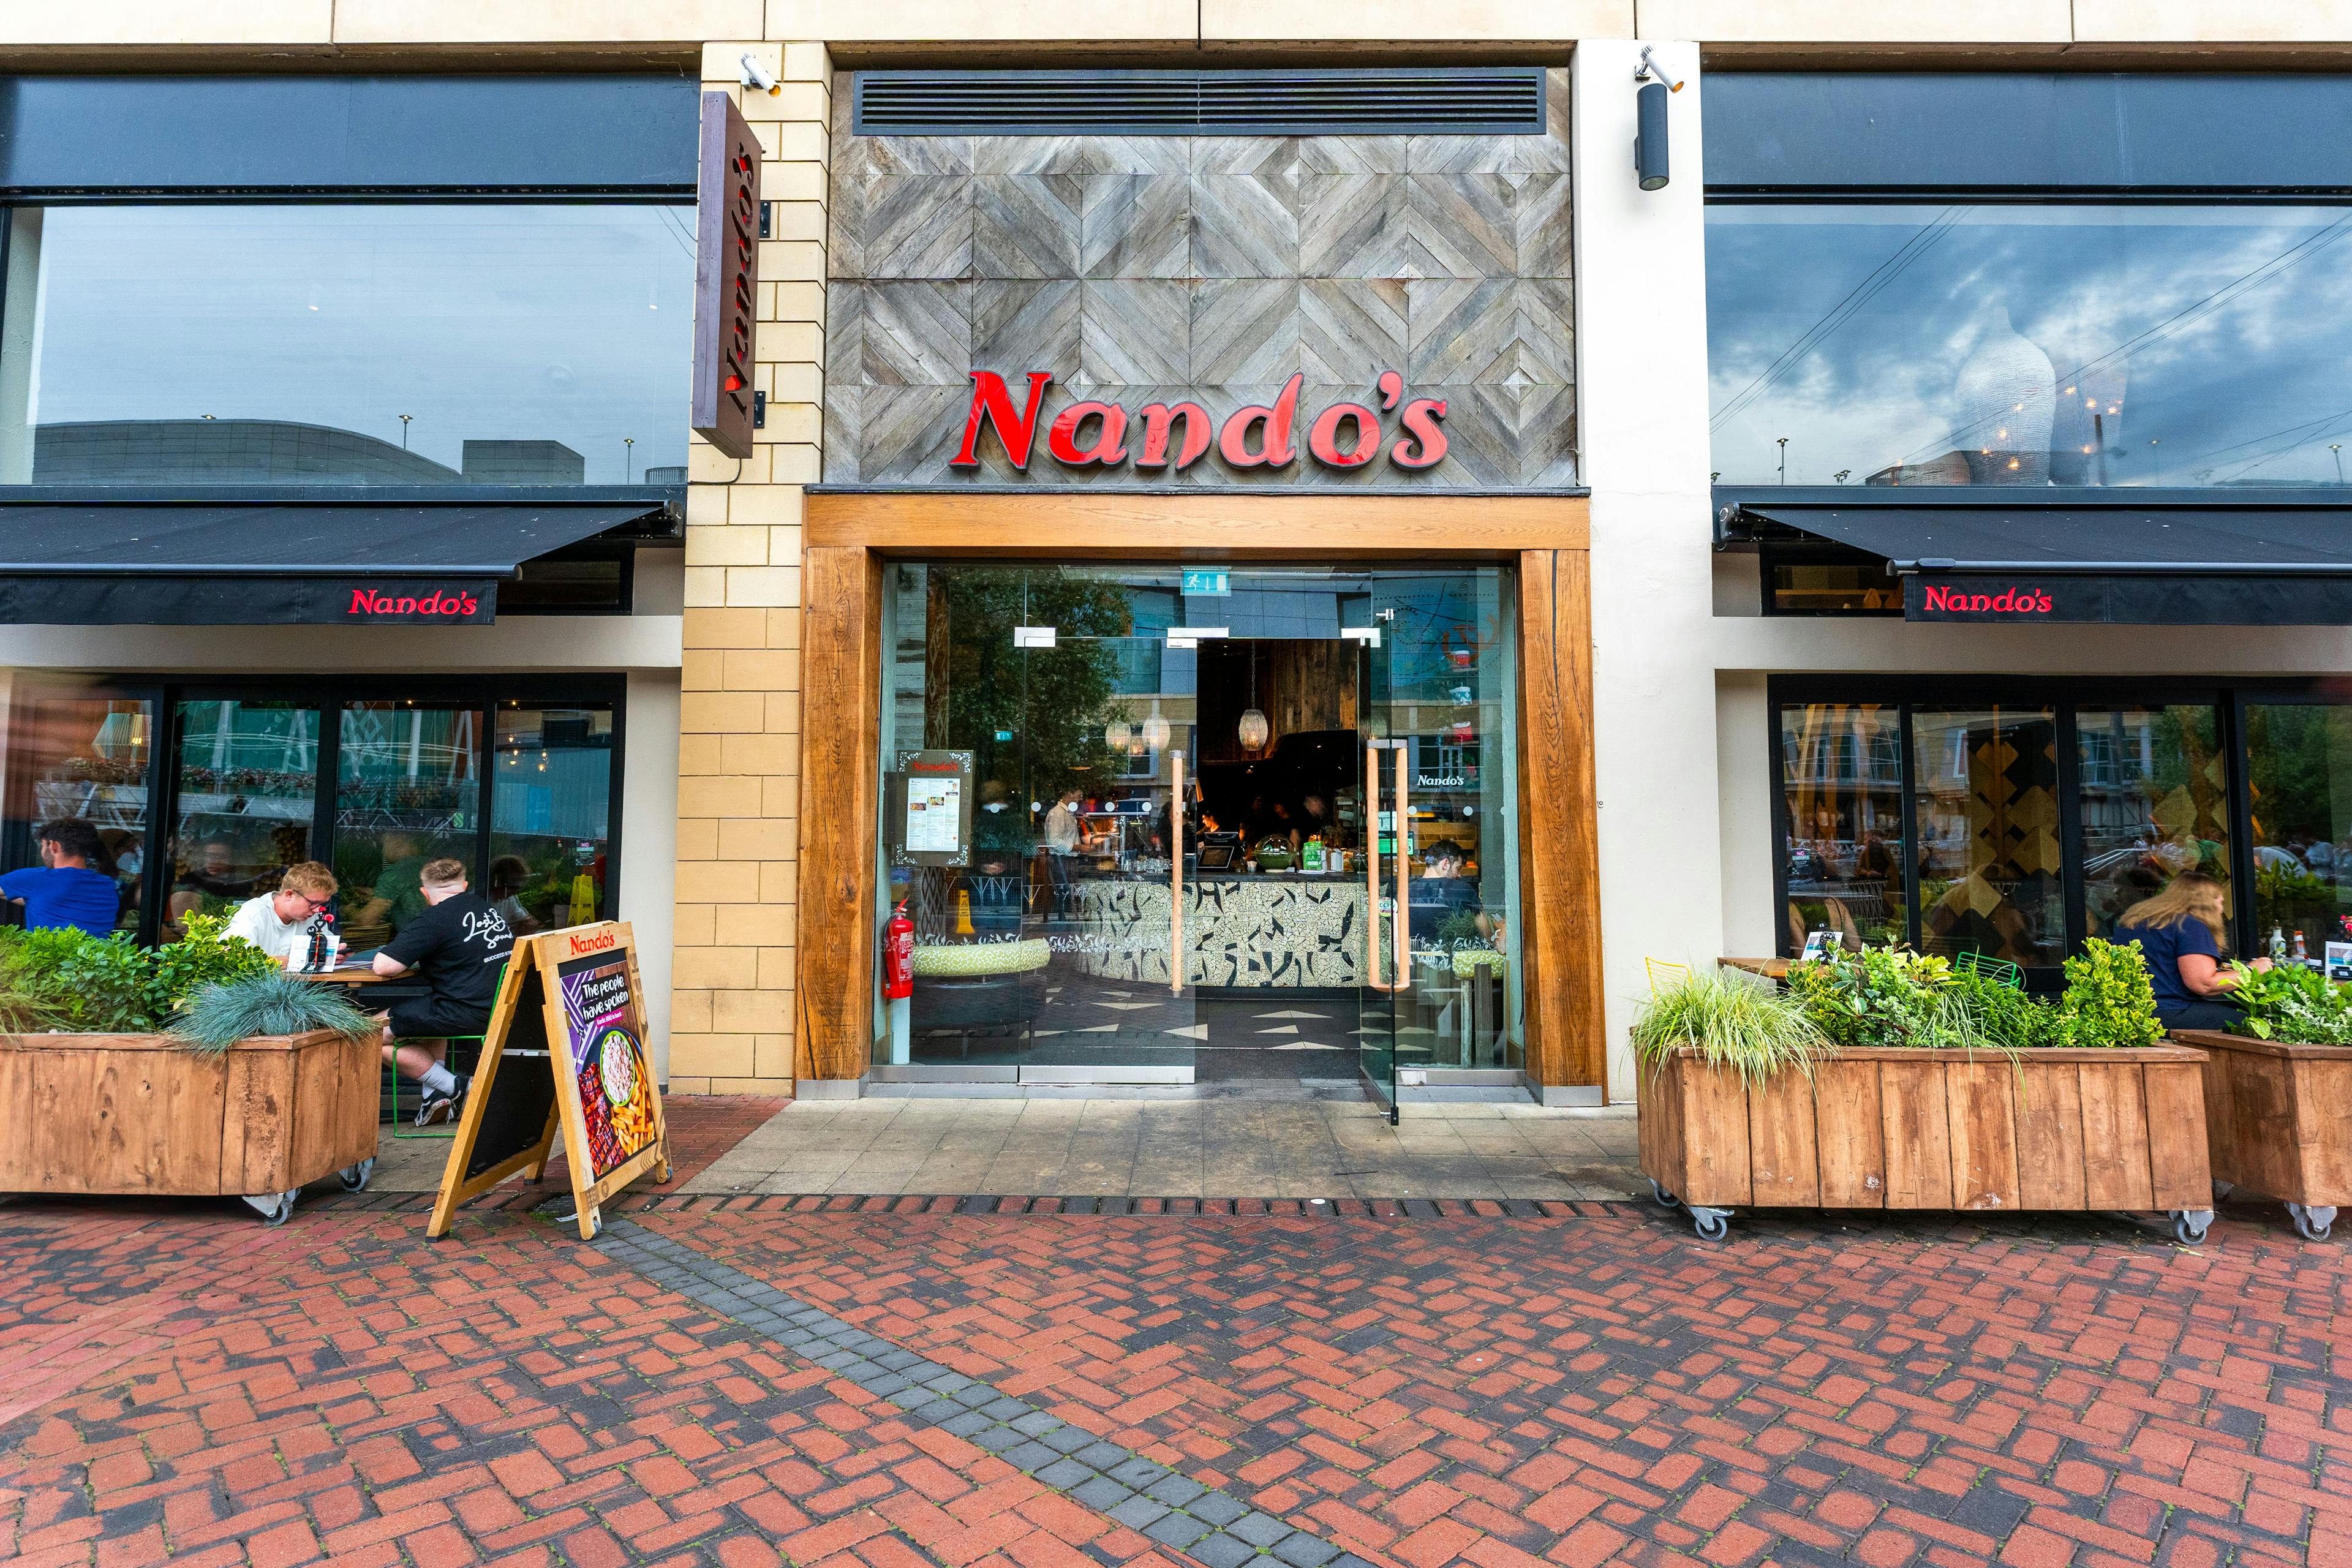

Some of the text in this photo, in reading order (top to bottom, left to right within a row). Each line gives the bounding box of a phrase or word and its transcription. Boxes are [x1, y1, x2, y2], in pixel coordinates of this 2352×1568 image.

[725, 141, 755, 424] Nando's
[948, 369, 1450, 473] Nando's
[347, 589, 477, 615] Nando's
[1923, 586, 2052, 612] Nando's
[1417, 775, 1464, 786] Nando's
[569, 929, 614, 956] Nando's
[483, 951, 505, 963] SUCCEED
[582, 974, 624, 998] The people
[582, 991, 628, 1021] have spoken
